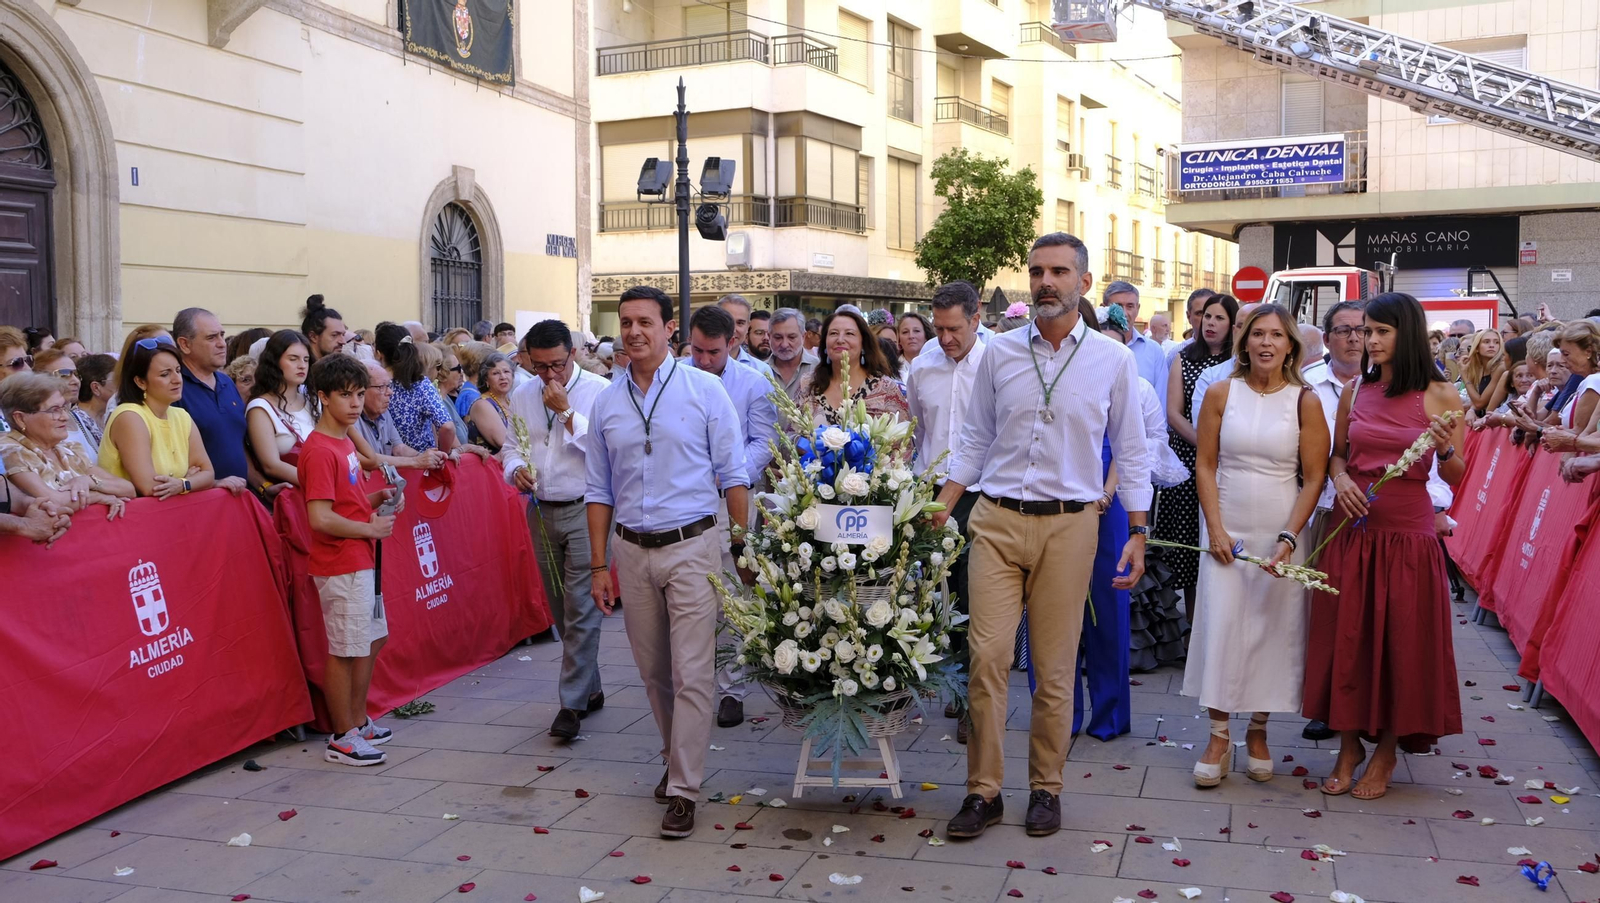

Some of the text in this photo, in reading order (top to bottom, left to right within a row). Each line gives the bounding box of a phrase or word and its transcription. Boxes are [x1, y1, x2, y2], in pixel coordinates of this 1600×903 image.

[1185, 143, 1339, 164] CLINICA DENTAL
[1221, 163, 1264, 172] Implantes
[1312, 158, 1342, 166] Dental
[1211, 173, 1257, 182] Alejandro
[1288, 168, 1332, 177] Calvache
[1184, 181, 1240, 189] ORTODONCIA
[547, 234, 575, 247] VIRGEN
[1367, 230, 1470, 245] MAÑAS CANO
[546, 245, 561, 257] DEL
[1367, 243, 1470, 254] INMOBILIARIA
[416, 572, 454, 602] ALMERÍA
[426, 593, 448, 610] CIUDAD
[130, 626, 194, 668] ALMERÍA
[148, 654, 184, 678] CIUDAD
